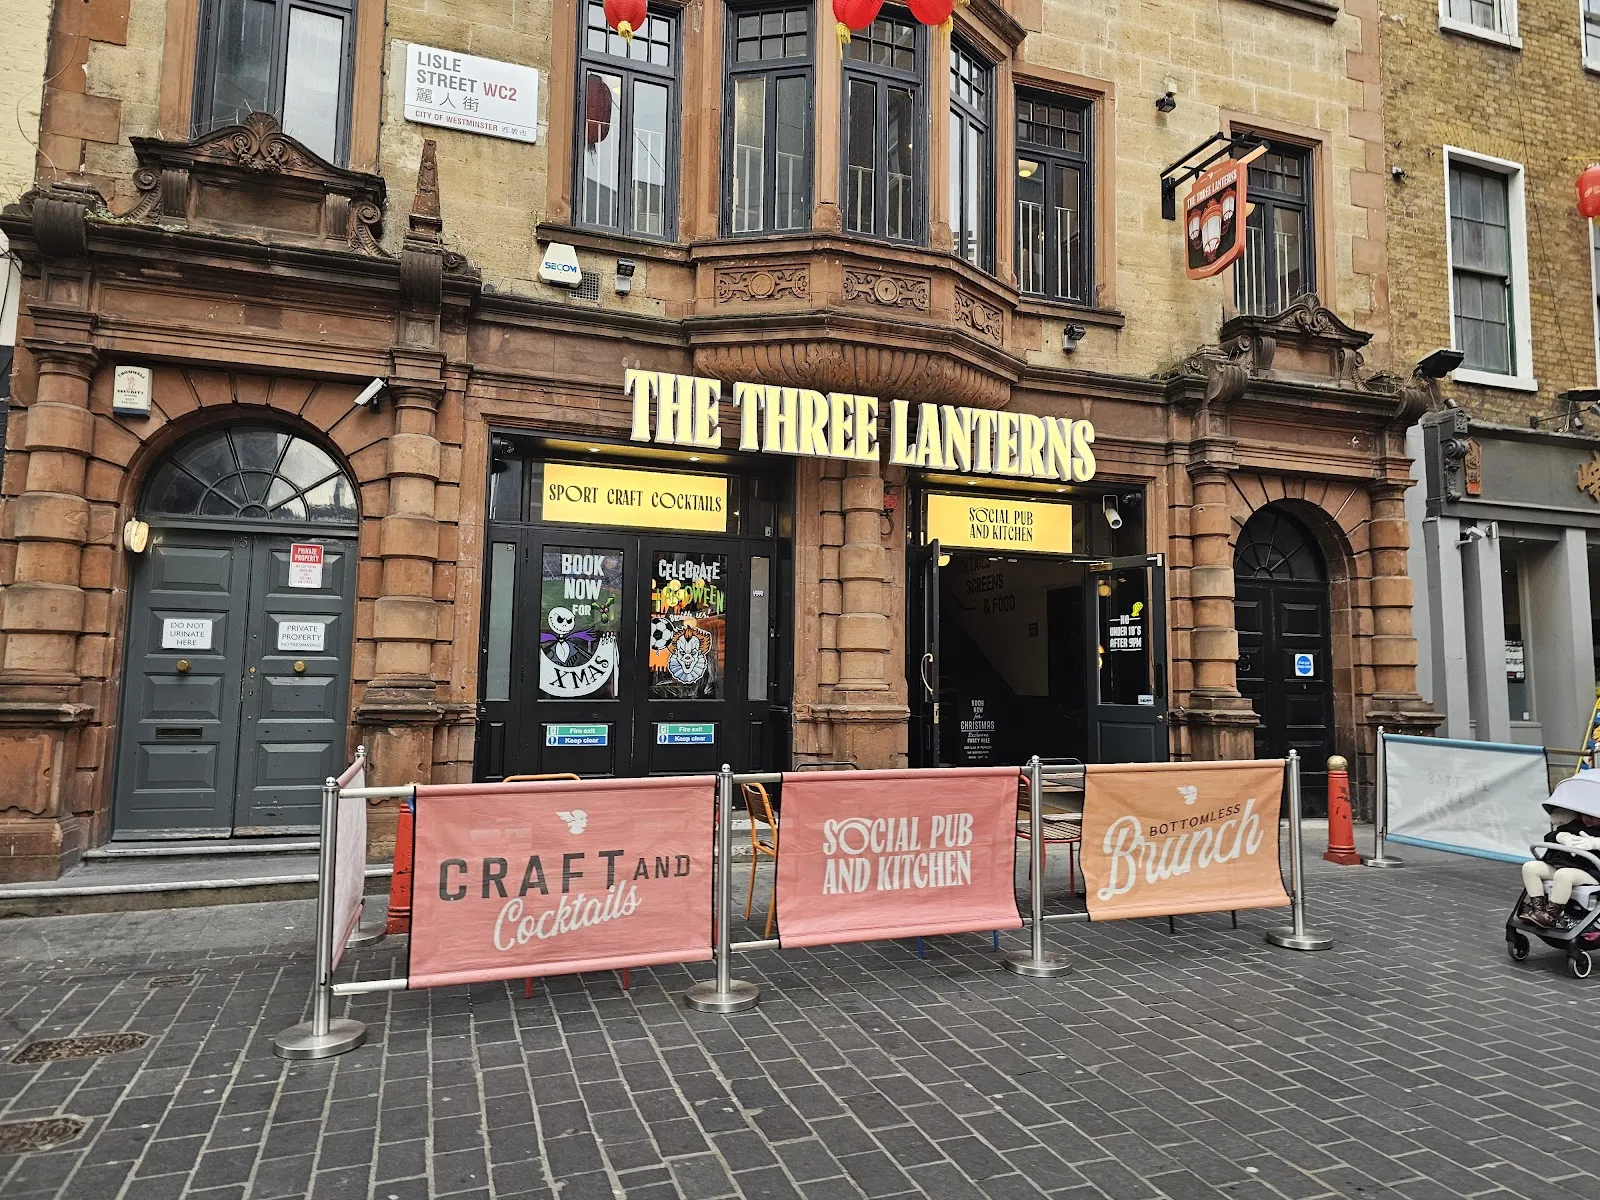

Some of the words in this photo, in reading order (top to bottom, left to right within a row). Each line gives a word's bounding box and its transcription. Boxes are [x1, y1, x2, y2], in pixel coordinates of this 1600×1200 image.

[417, 51, 462, 73] LISLE
[416, 69, 478, 94] STREET
[483, 81, 518, 102] WC2
[415, 87, 480, 113] 麗人街
[415, 110, 432, 120] CITY
[434, 113, 444, 121] OF
[446, 115, 498, 132] WESTMINSTER
[544, 261, 577, 273] SECOM
[623, 368, 723, 449] THE
[732, 381, 880, 462] THREE
[889, 398, 1098, 483] LANTERNS
[549, 483, 599, 504] SPORT
[606, 488, 644, 507] CRAFT
[651, 491, 722, 513] COCKTAILS
[969, 506, 1011, 525] SOCIAL
[1014, 510, 1033, 526] PUB
[969, 523, 990, 539] AND
[992, 525, 1033, 542] KITCHEN
[294, 554, 320, 562] PROPERTY
[297, 547, 318, 555] PRIVATE
[561, 553, 606, 577] BOOK
[658, 558, 721, 584] CELEBRATE
[563, 578, 603, 601] NOW
[966, 573, 1004, 595] SCREENS
[572, 604, 592, 616] FOR
[992, 594, 1016, 614] FOOD
[186, 622, 205, 630] NOT
[1120, 614, 1130, 625] NO
[169, 630, 205, 639] URINATE
[282, 633, 322, 641] PROPERTY
[1109, 626, 1128, 637] UNDER
[1109, 638, 1128, 648] AFTER
[549, 655, 610, 690] XMAS
[569, 727, 583, 735] Fire
[584, 727, 596, 735] exit
[960, 720, 995, 730] CHRISTMAS
[564, 737, 582, 745] Keep
[674, 735, 690, 743] Keep
[1149, 803, 1241, 837] BOTTOMLESS
[822, 817, 922, 856] SOCIAL
[929, 812, 975, 849] PUB
[1096, 798, 1265, 902] Brunch
[438, 850, 625, 902] CRAFT
[632, 854, 691, 881] AND
[822, 857, 872, 895] AND
[876, 850, 972, 892] KITCHEN
[493, 879, 643, 951] Cocktails
